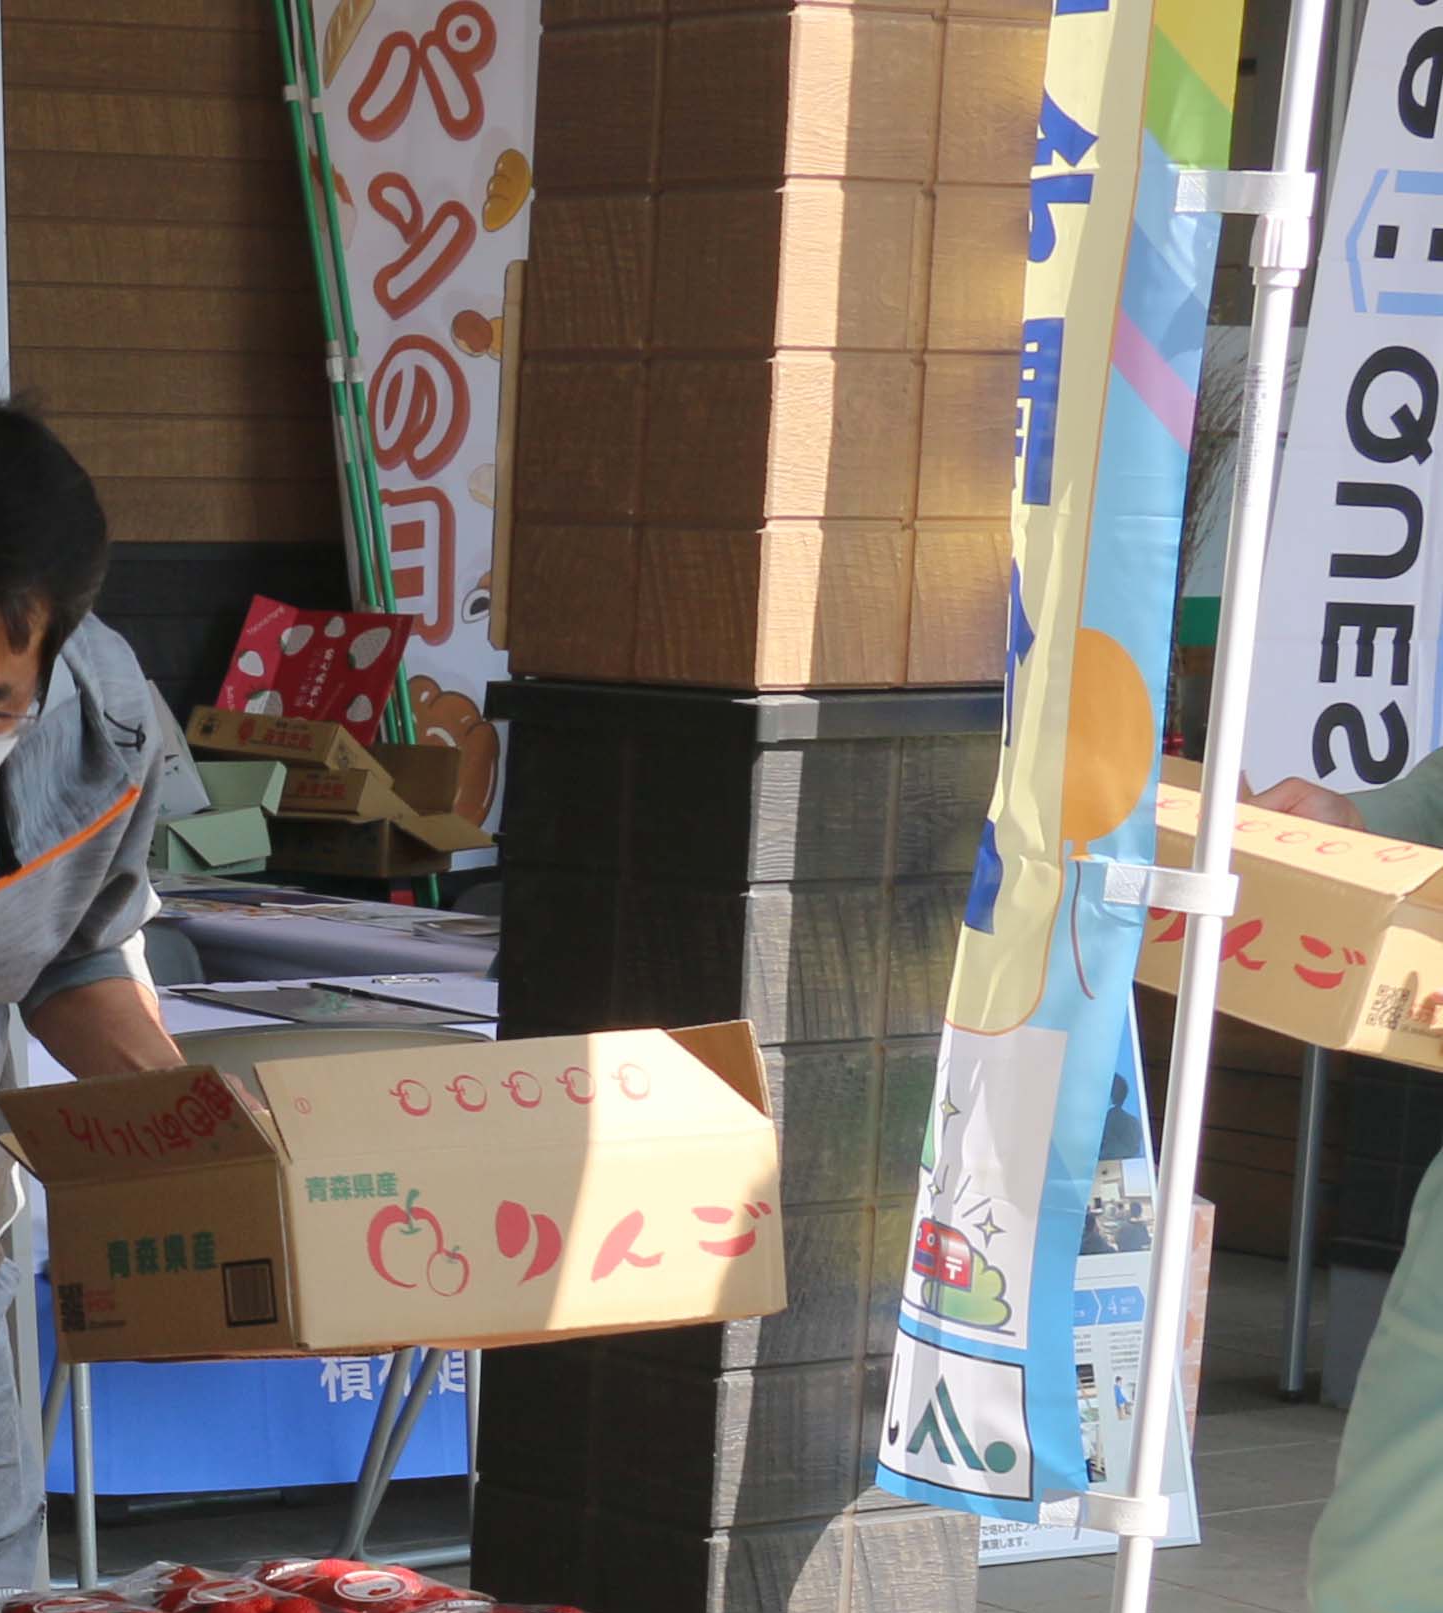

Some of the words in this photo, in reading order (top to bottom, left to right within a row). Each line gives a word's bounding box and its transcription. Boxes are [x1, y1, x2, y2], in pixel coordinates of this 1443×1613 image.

[304, 1169, 399, 1203] 青森県産
[494, 1199, 775, 1284] りんご
